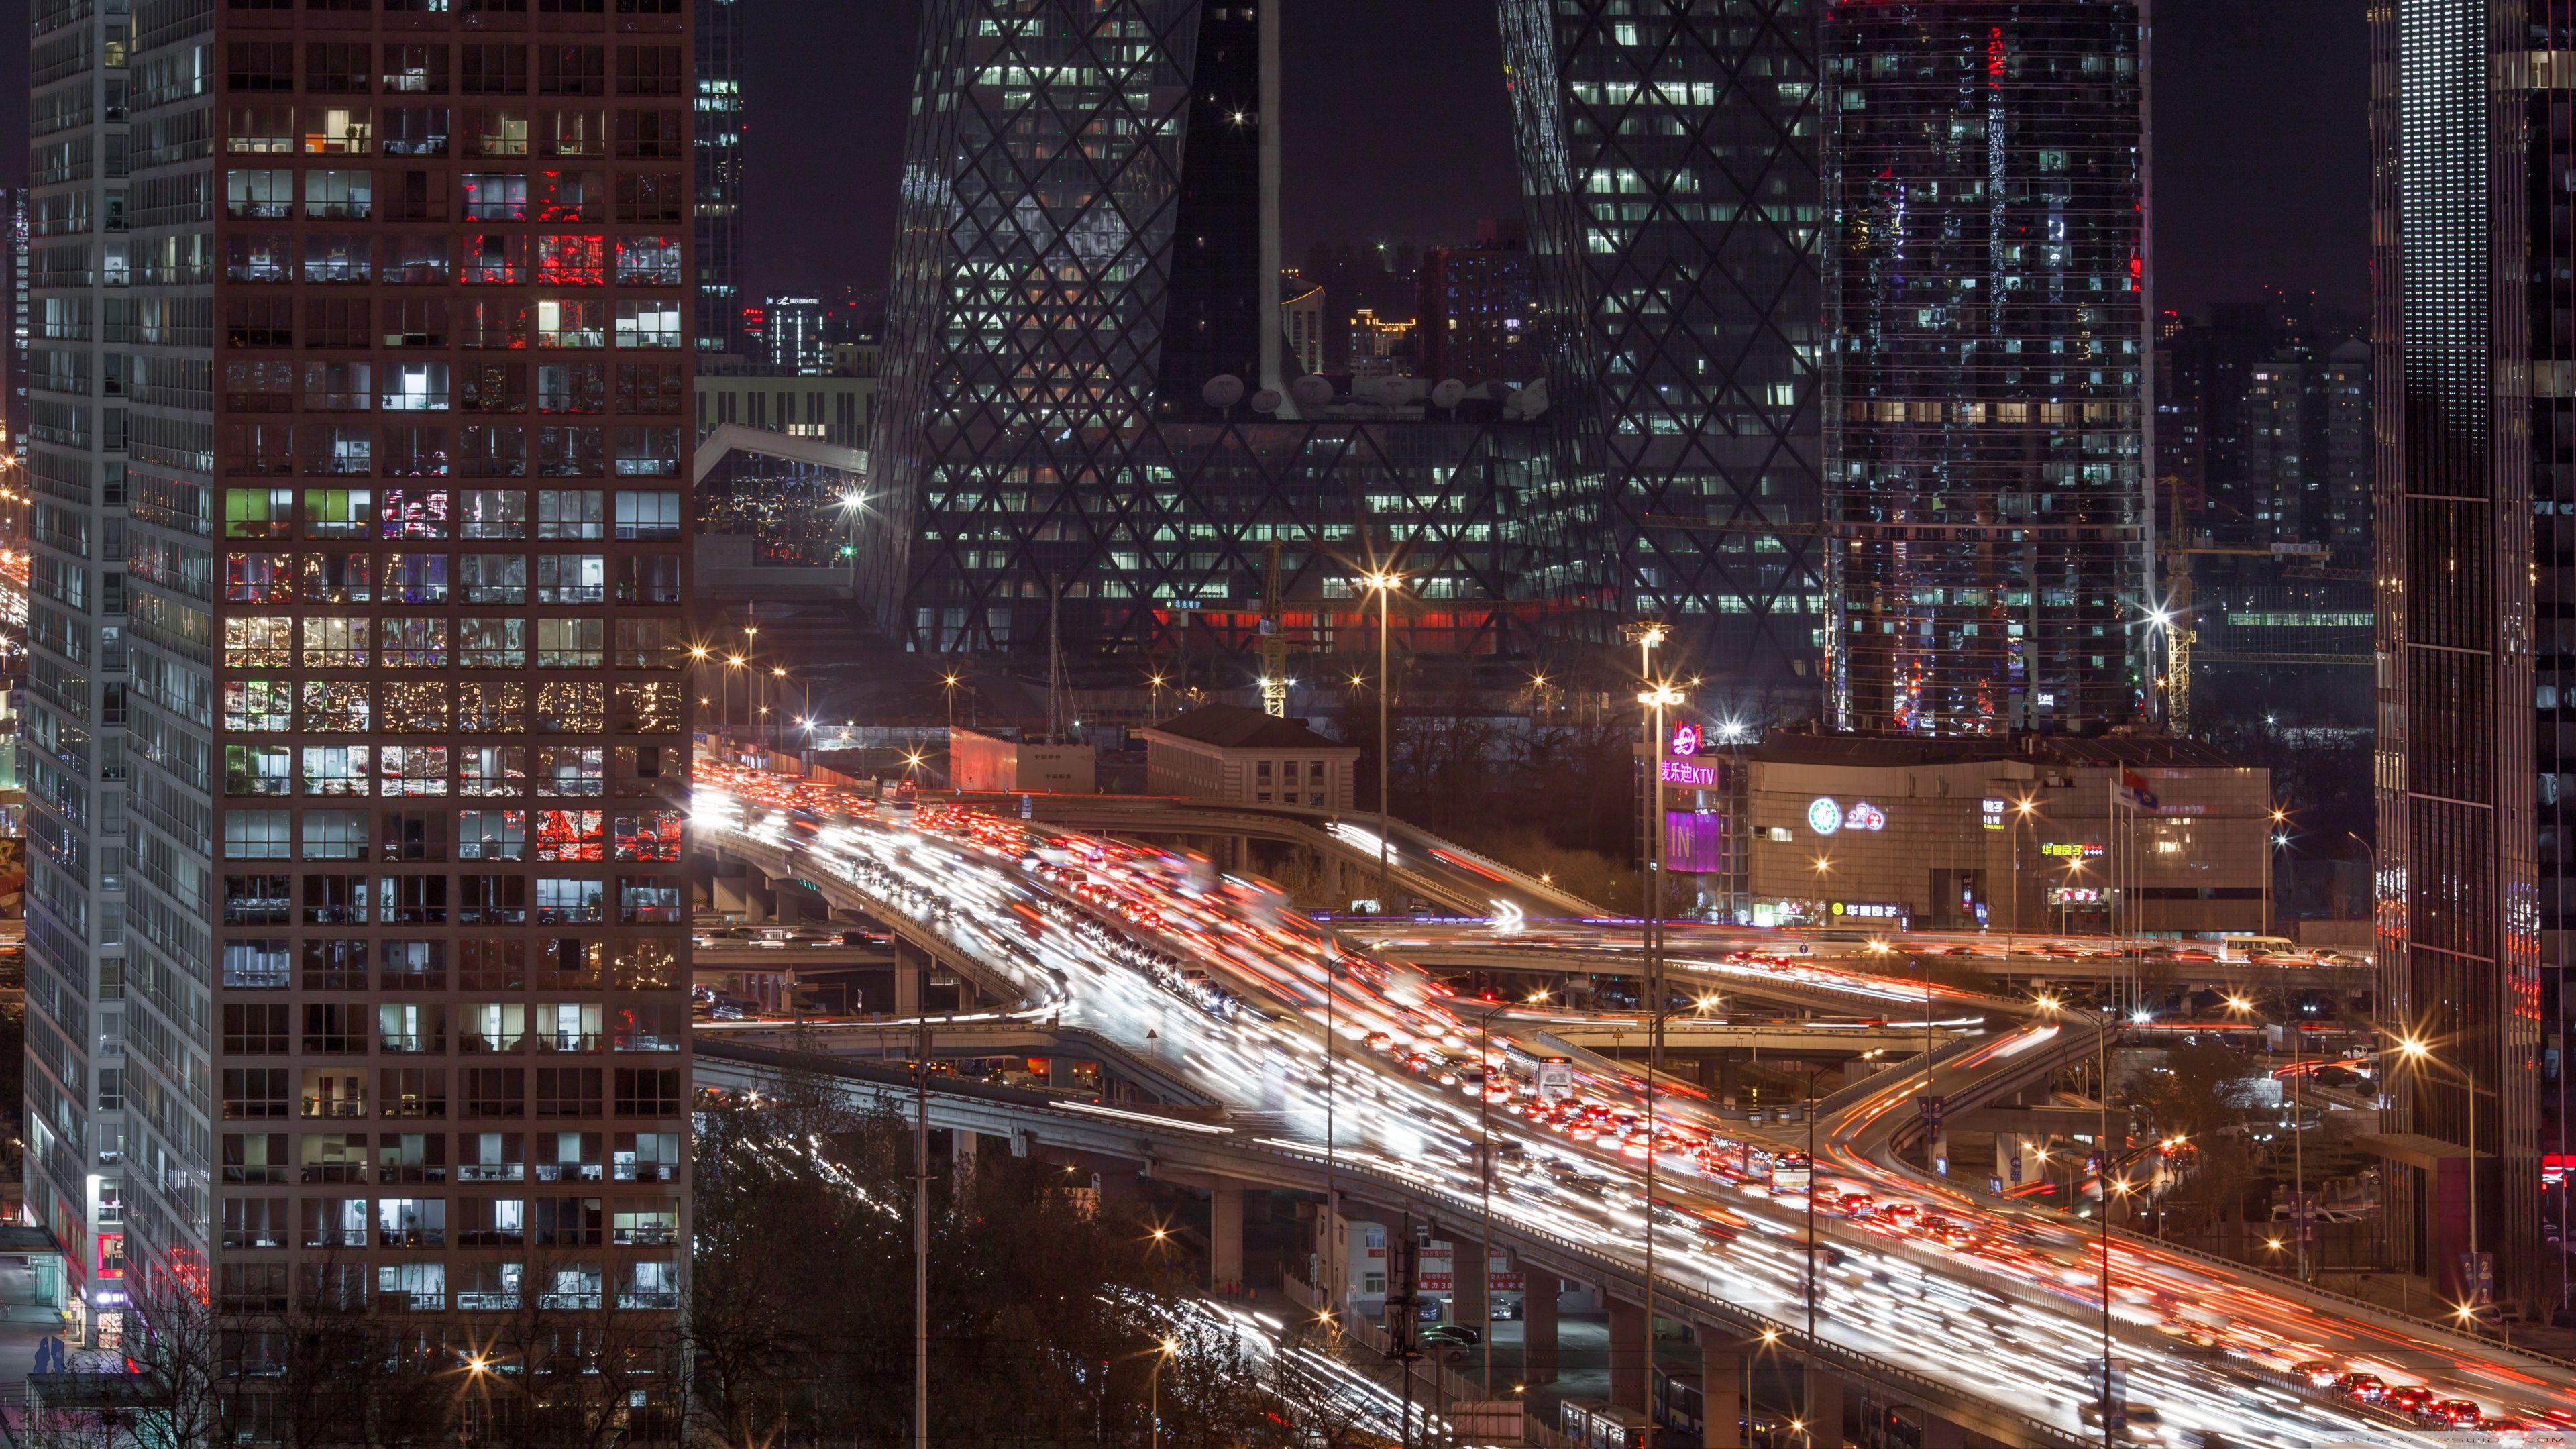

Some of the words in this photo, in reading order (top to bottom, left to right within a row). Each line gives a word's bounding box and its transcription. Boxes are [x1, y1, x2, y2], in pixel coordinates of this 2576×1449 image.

[1661, 760, 1715, 785] 麦乐迪KTV
[2041, 844, 2082, 855] 华夏良子
